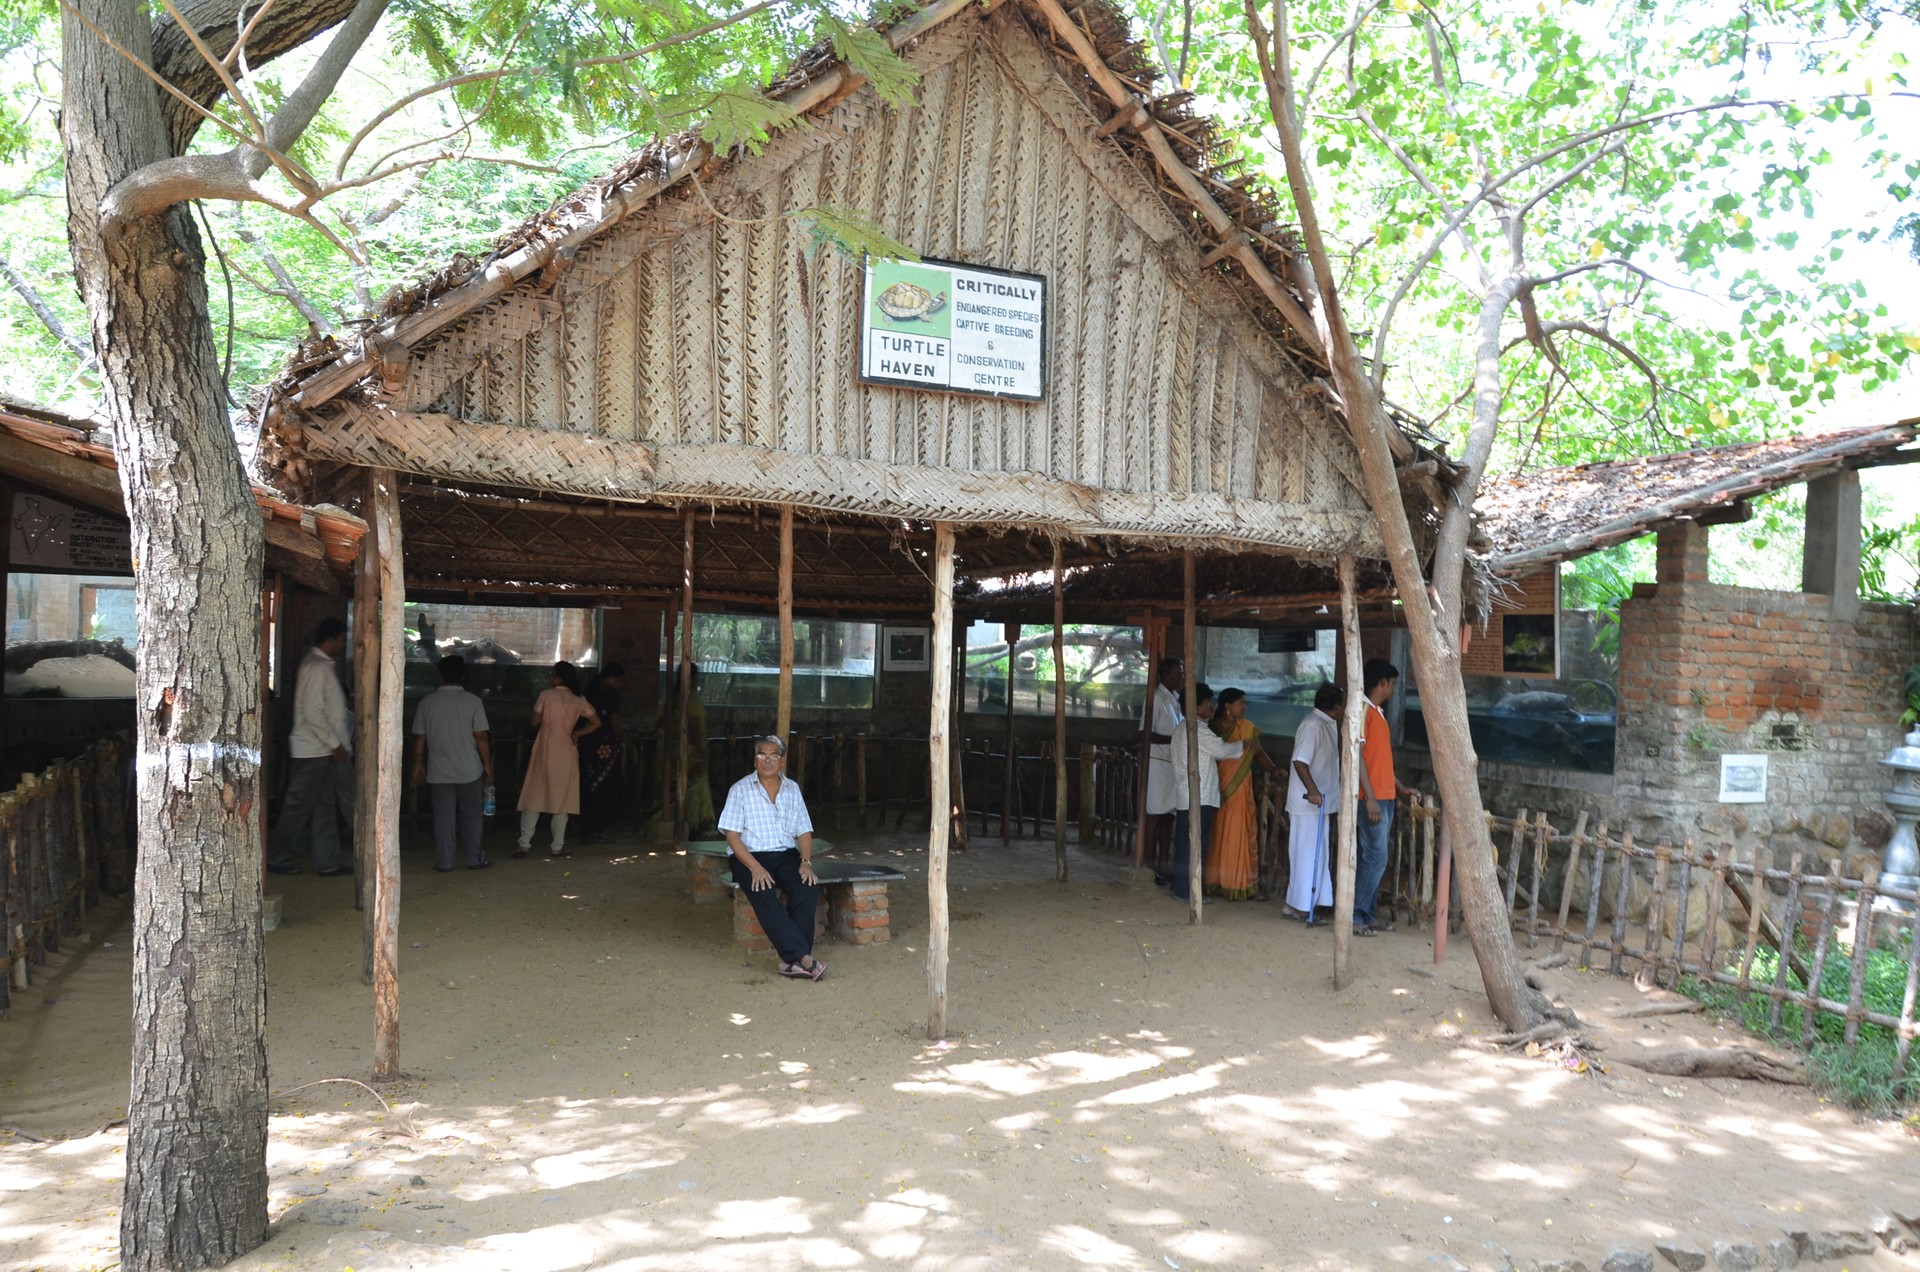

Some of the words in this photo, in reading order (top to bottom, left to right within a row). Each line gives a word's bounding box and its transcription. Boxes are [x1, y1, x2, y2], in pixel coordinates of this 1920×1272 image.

[956, 279, 1037, 301] CRITICALLY
[956, 301, 1007, 318] ENDANGERED
[1008, 310, 1040, 323] SPECIES
[956, 318, 990, 333] CAPTIVE
[994, 325, 1034, 339] BREEDING
[881, 336, 945, 357] TURTLE
[987, 341, 994, 350] &
[880, 359, 935, 378] HAVEN
[956, 353, 1025, 371] CONSERVATION
[974, 372, 1015, 387] CENTRE
